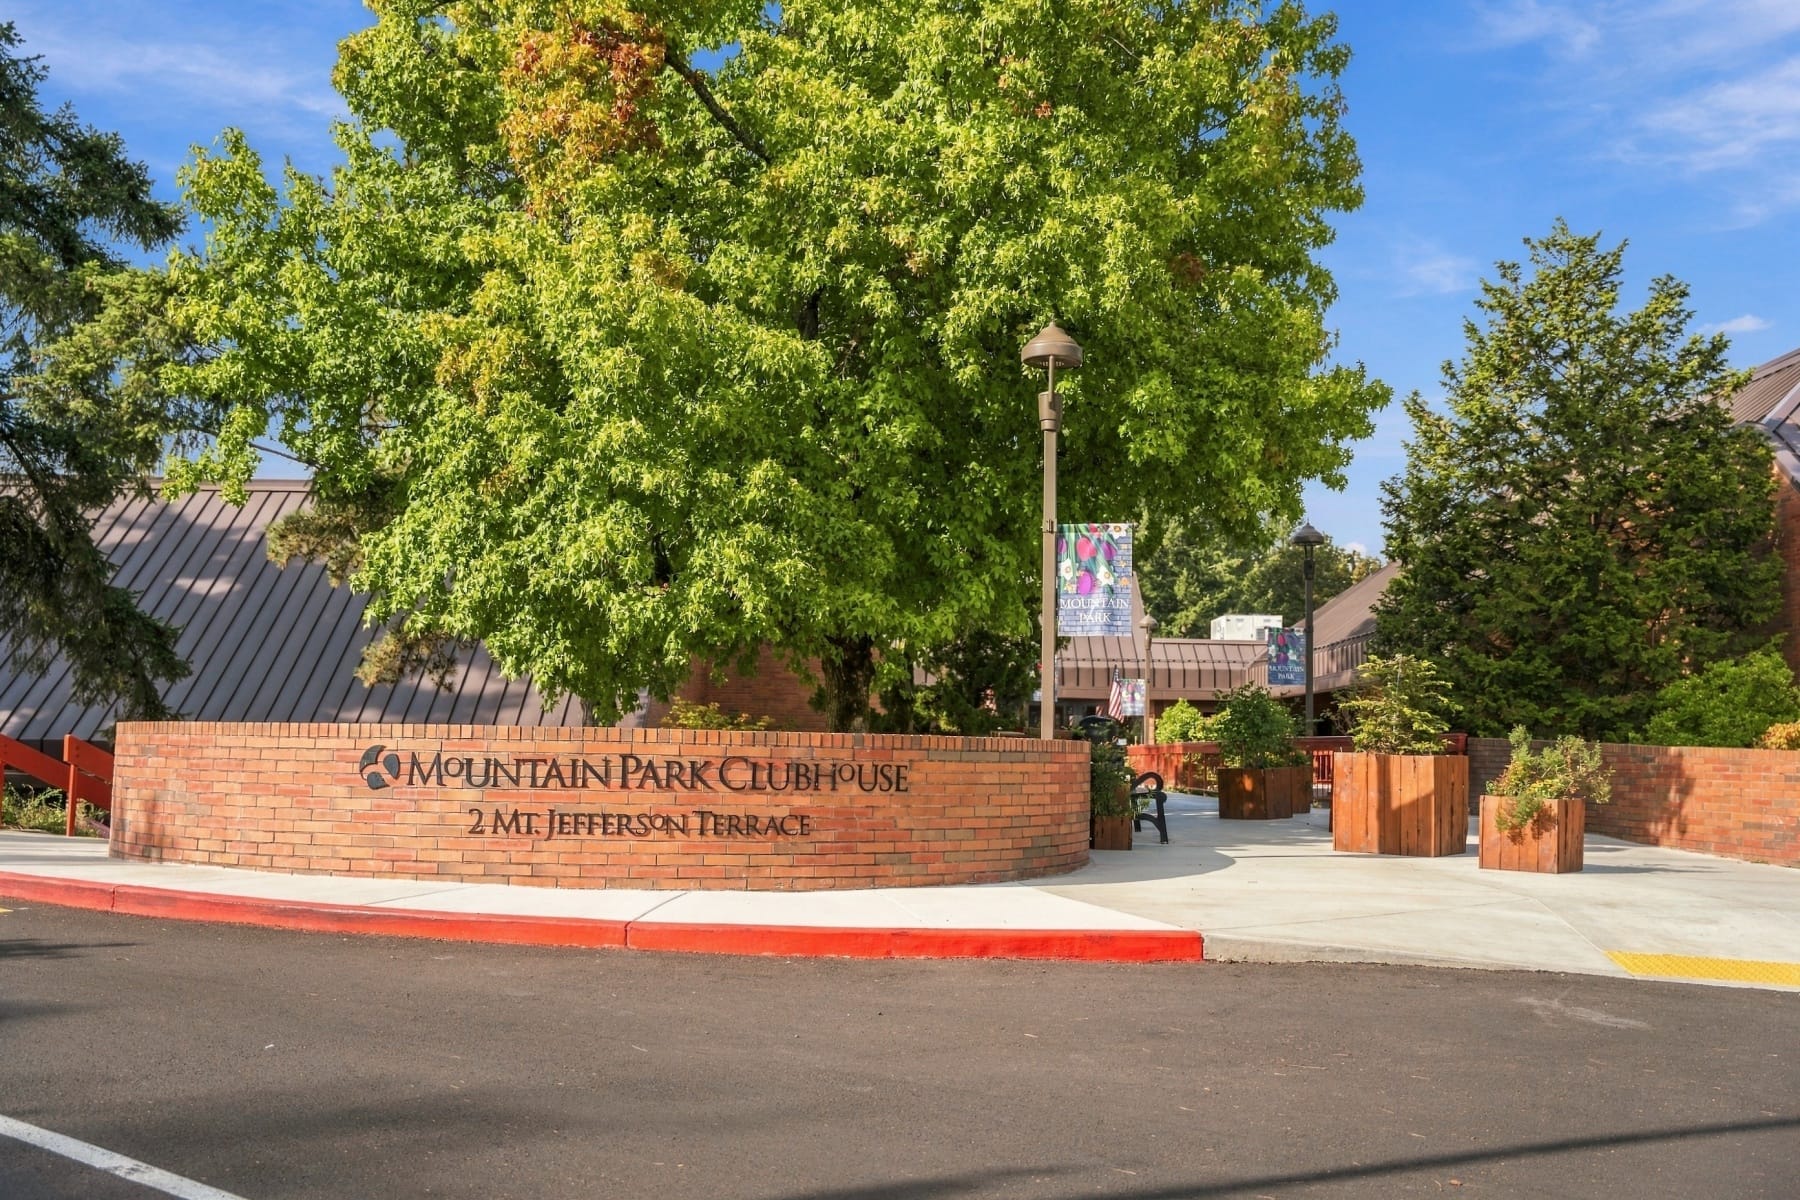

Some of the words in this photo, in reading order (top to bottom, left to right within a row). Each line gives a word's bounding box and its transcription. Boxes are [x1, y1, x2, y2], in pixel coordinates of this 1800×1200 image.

[1079, 612, 1111, 623] PARK
[407, 751, 611, 789] MOUNTAIN
[619, 754, 713, 792] PARK
[718, 756, 909, 793] CLUBHOUSE
[468, 808, 486, 835] 2
[491, 808, 540, 835] MT.
[544, 808, 686, 842] JEFFERSON
[692, 810, 810, 837] TERRACE
